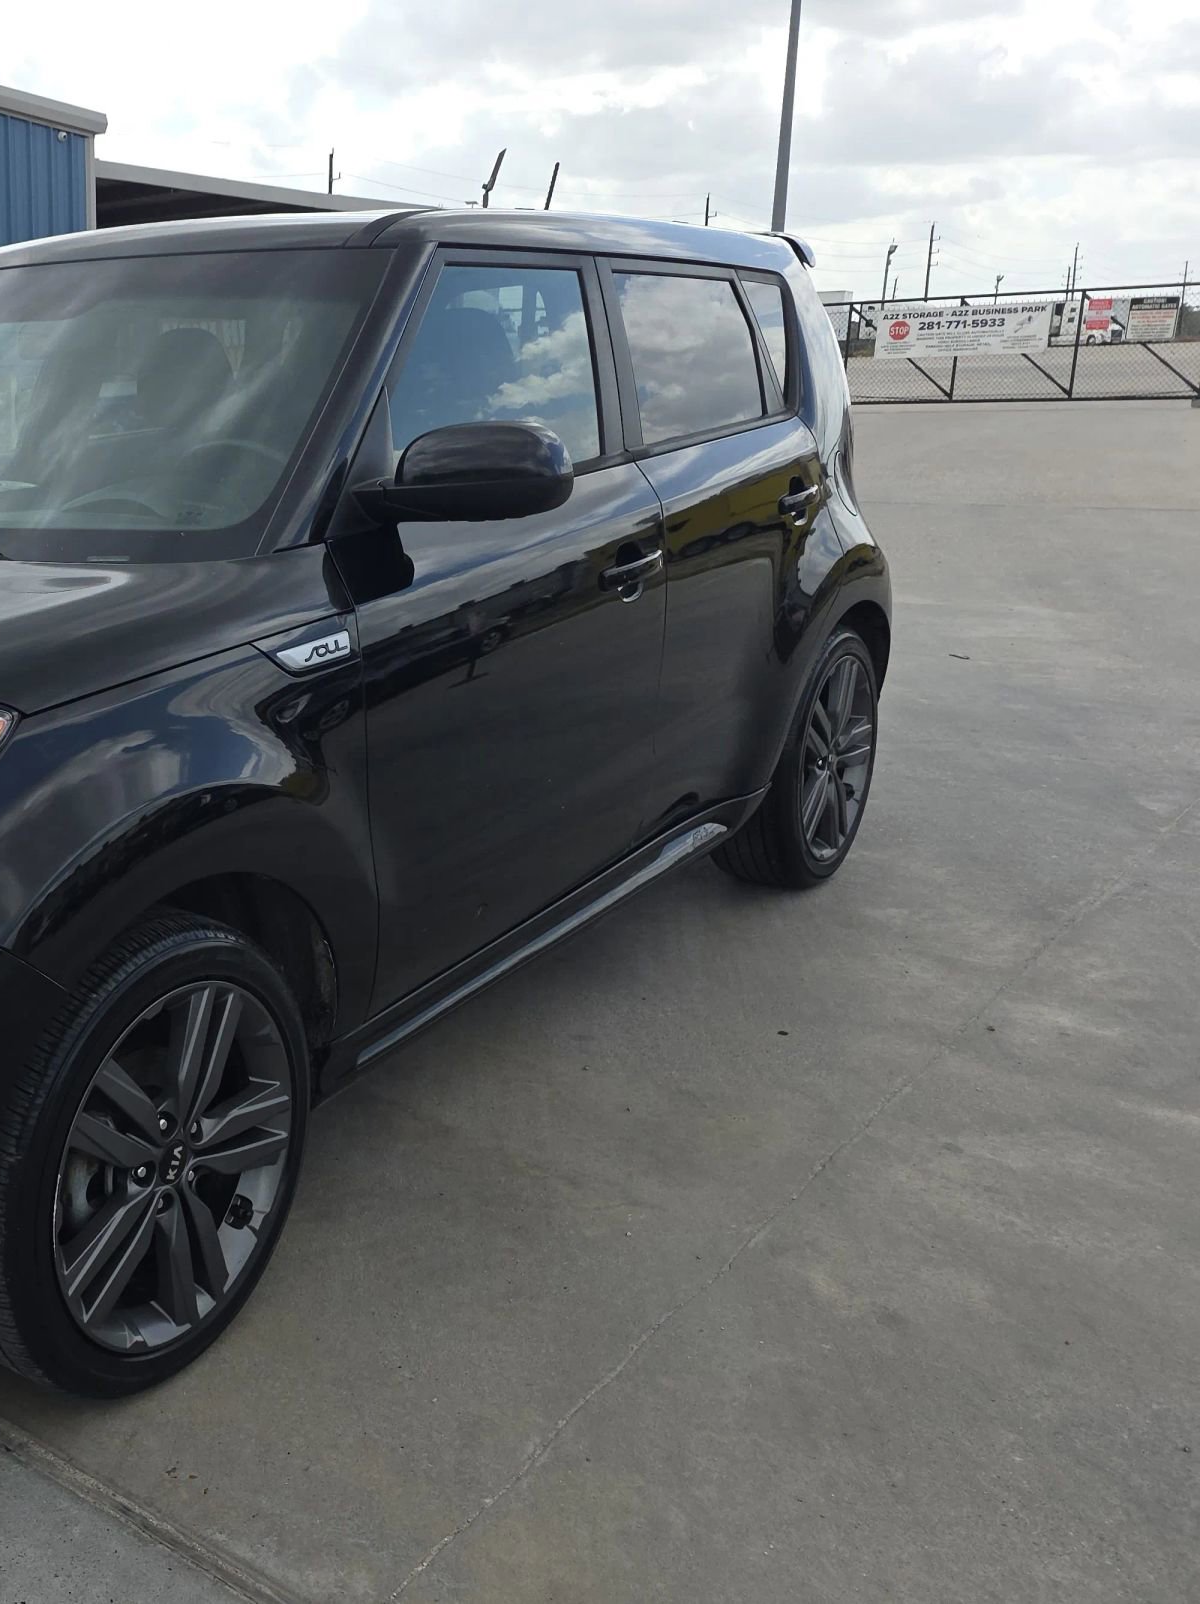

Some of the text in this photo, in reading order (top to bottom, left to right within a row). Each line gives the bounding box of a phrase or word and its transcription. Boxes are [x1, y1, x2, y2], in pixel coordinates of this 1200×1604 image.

[882, 313, 901, 321] A2Z
[902, 310, 945, 320] STORAGE
[951, 309, 970, 317] A2Z
[971, 306, 1019, 316] BUSINESS
[1021, 304, 1048, 313] PARK
[889, 326, 910, 336] STOP
[918, 318, 1006, 331] 281-771-5933
[166, 1145, 183, 1180] KIA
